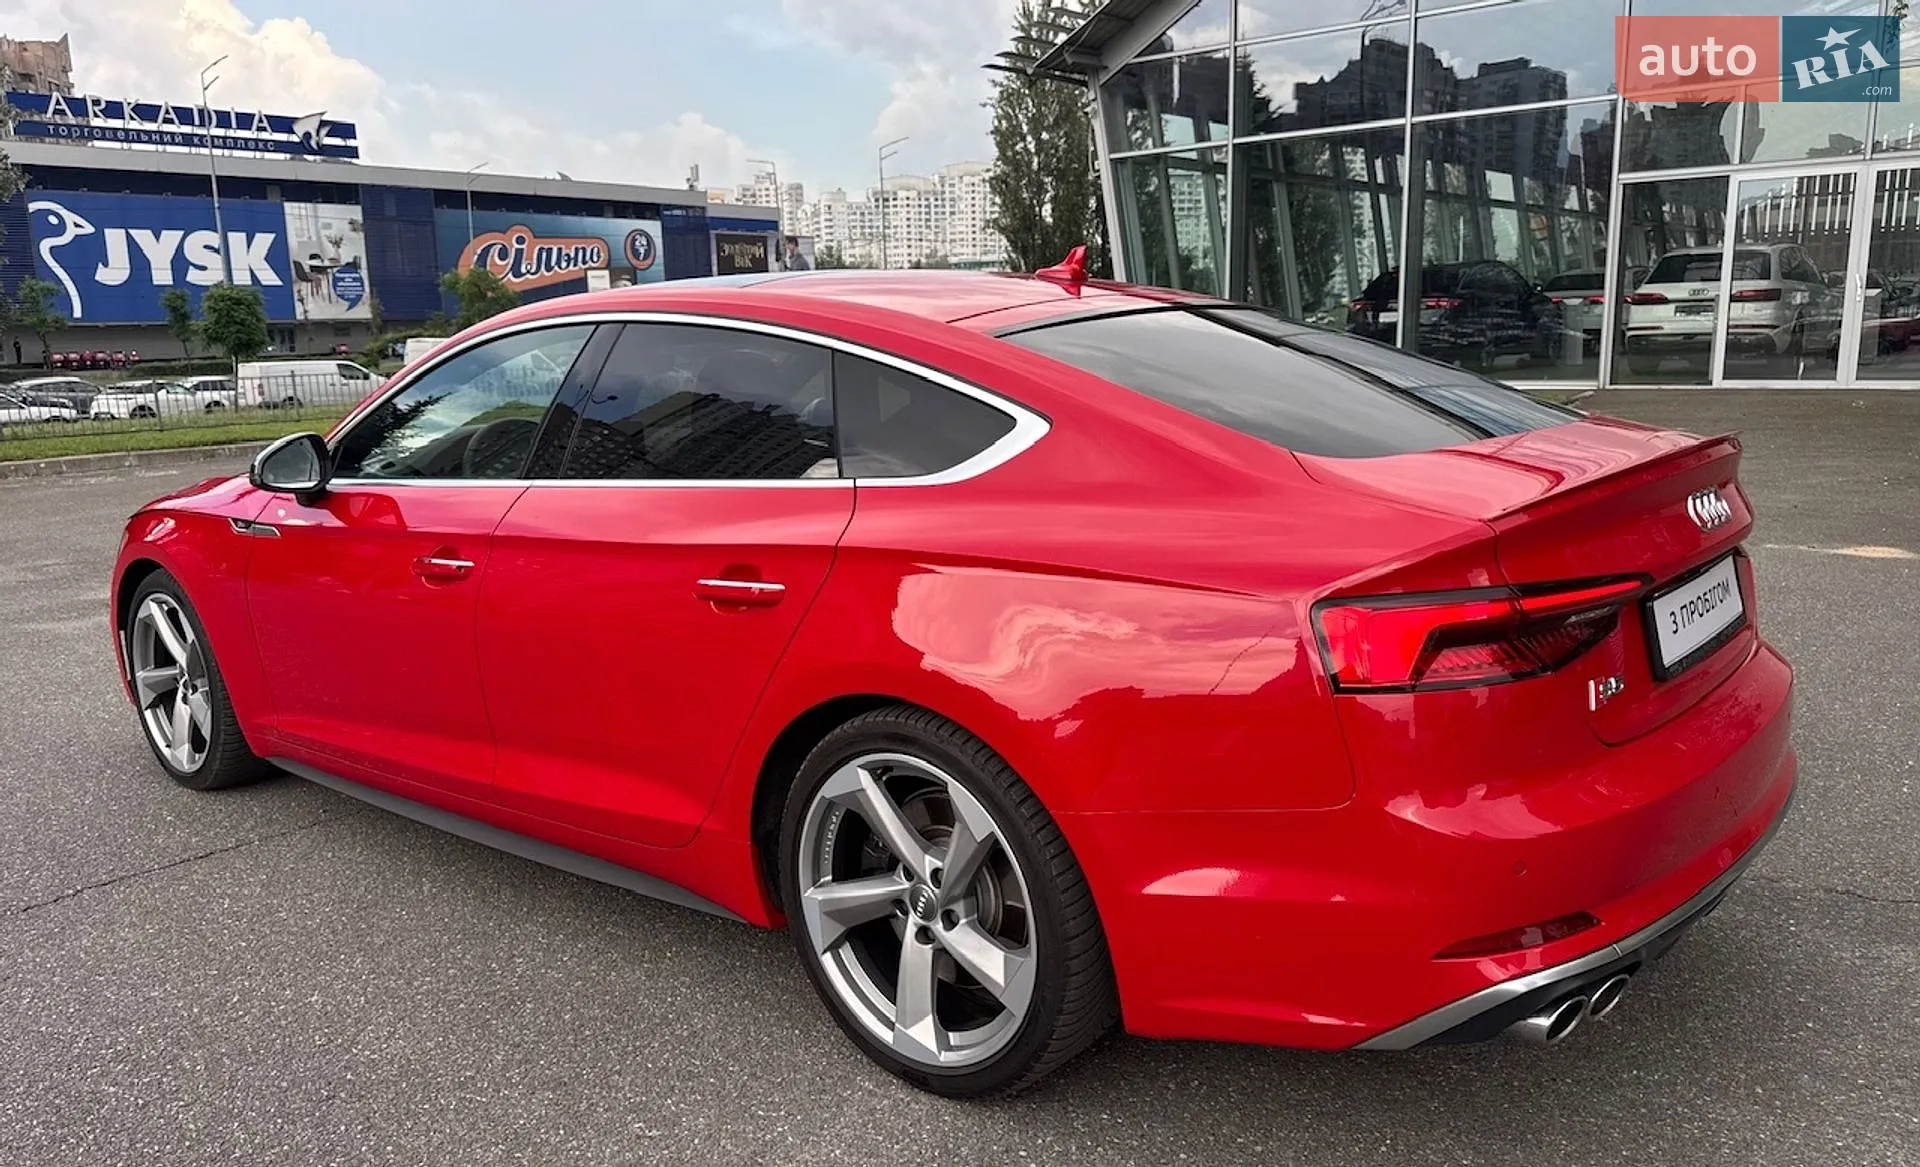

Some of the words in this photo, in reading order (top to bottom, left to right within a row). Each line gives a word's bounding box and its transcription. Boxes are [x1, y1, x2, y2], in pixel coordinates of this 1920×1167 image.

[46, 91, 273, 136] ARKADIA
[47, 124, 183, 144] торговельний
[193, 136, 276, 151] комплекс
[94, 228, 284, 286] JYSK
[472, 233, 604, 284] Сільпо
[1680, 577, 1732, 629] ПРОБІГОМ
